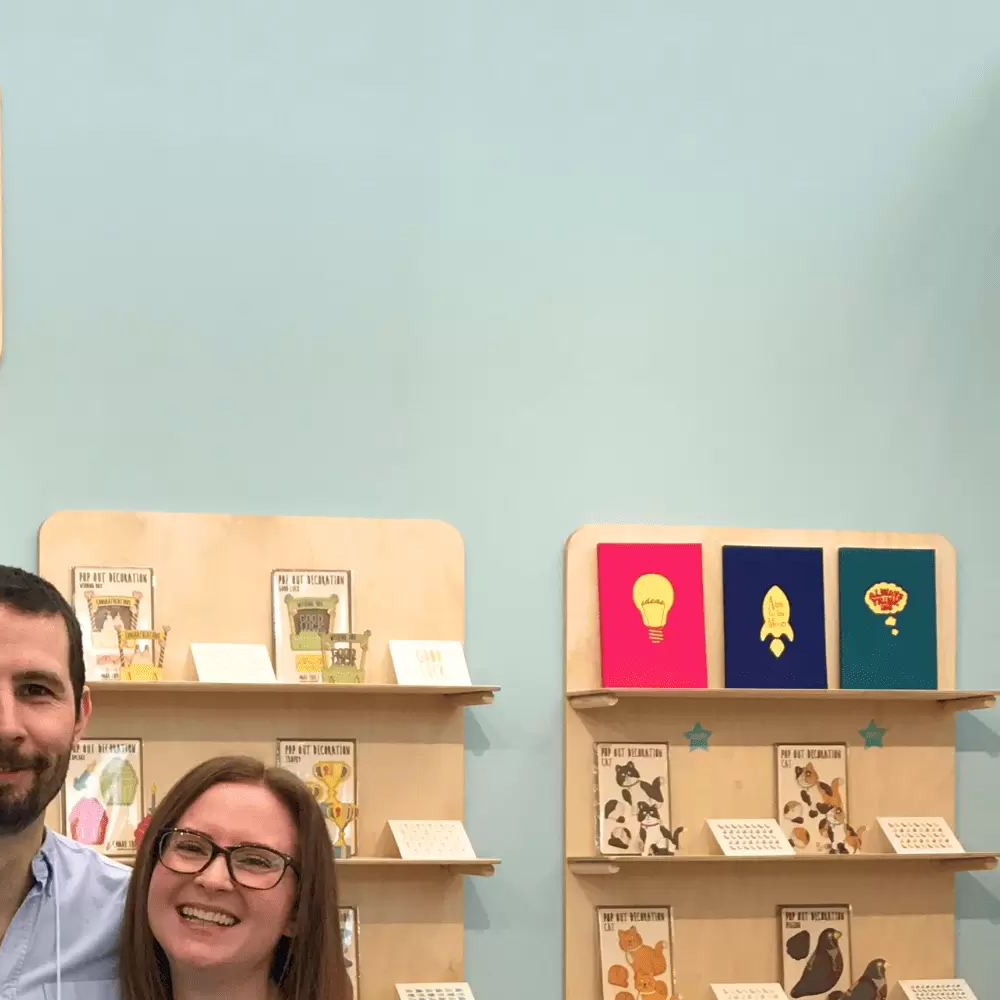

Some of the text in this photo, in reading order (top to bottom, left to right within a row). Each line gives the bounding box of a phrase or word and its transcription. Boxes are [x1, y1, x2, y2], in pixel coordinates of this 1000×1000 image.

[79, 572, 148, 583] POP OUT DECORATION
[292, 575, 304, 585] OUT
[307, 575, 345, 586] DECORATION
[72, 744, 80, 753] OP
[285, 745, 351, 756] POP OUT DECORATION
